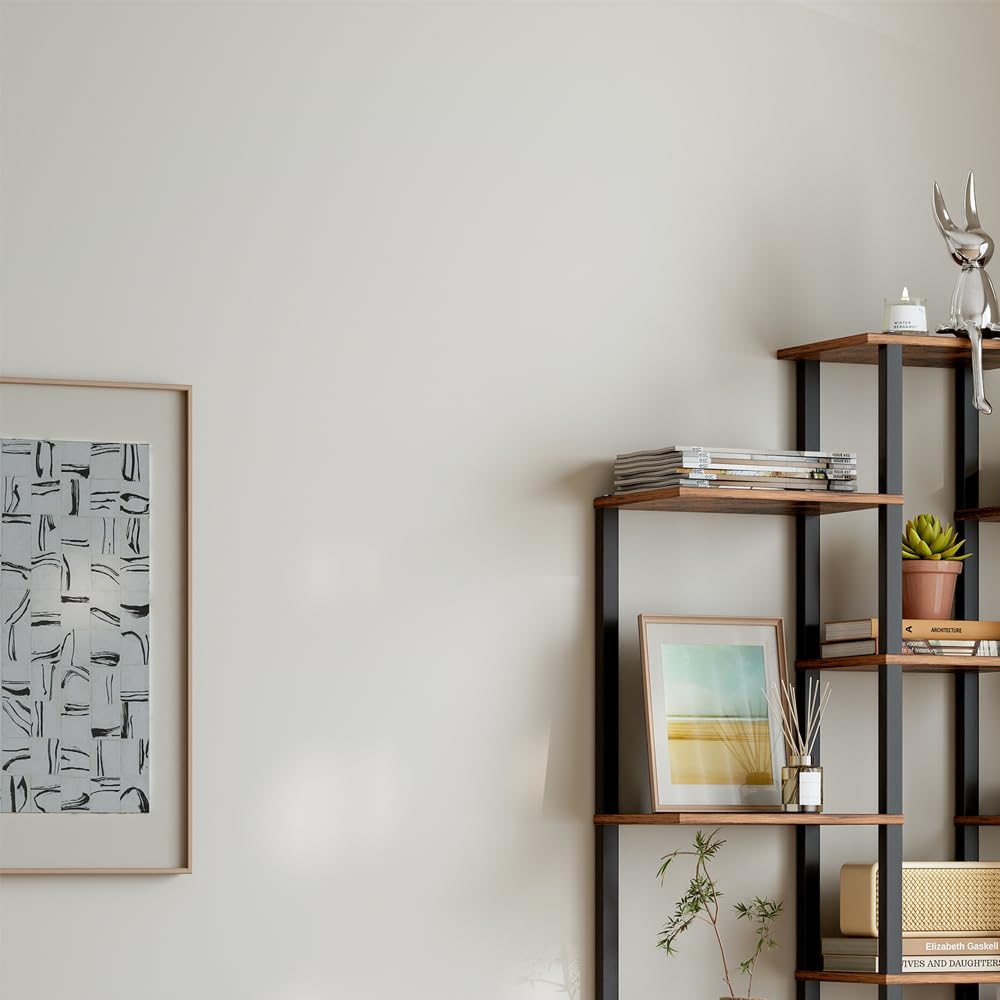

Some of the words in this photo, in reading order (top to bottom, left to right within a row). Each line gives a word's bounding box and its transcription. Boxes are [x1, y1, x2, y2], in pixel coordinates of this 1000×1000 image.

[925, 941, 965, 951] Elizabeth
[967, 941, 999, 950] Gaskell
[927, 959, 947, 968] AND
